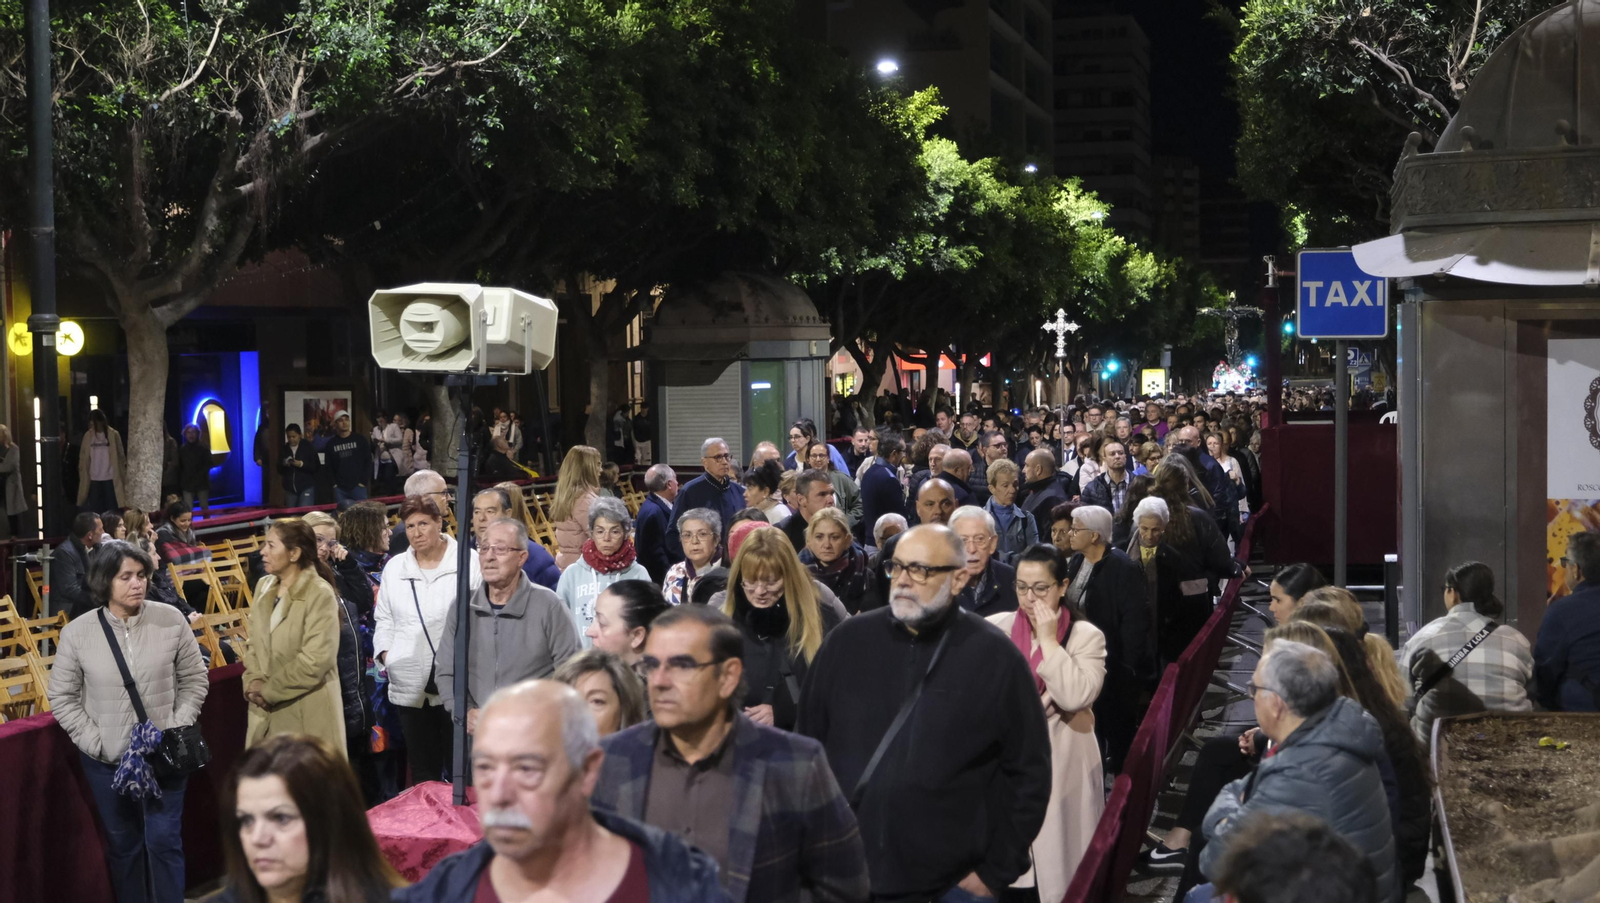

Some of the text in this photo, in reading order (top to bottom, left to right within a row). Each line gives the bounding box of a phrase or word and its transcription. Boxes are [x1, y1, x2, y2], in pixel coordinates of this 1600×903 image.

[1302, 280, 1384, 307] TAXI
[1466, 642, 1474, 650] Y
[1471, 629, 1490, 645] LOLA
